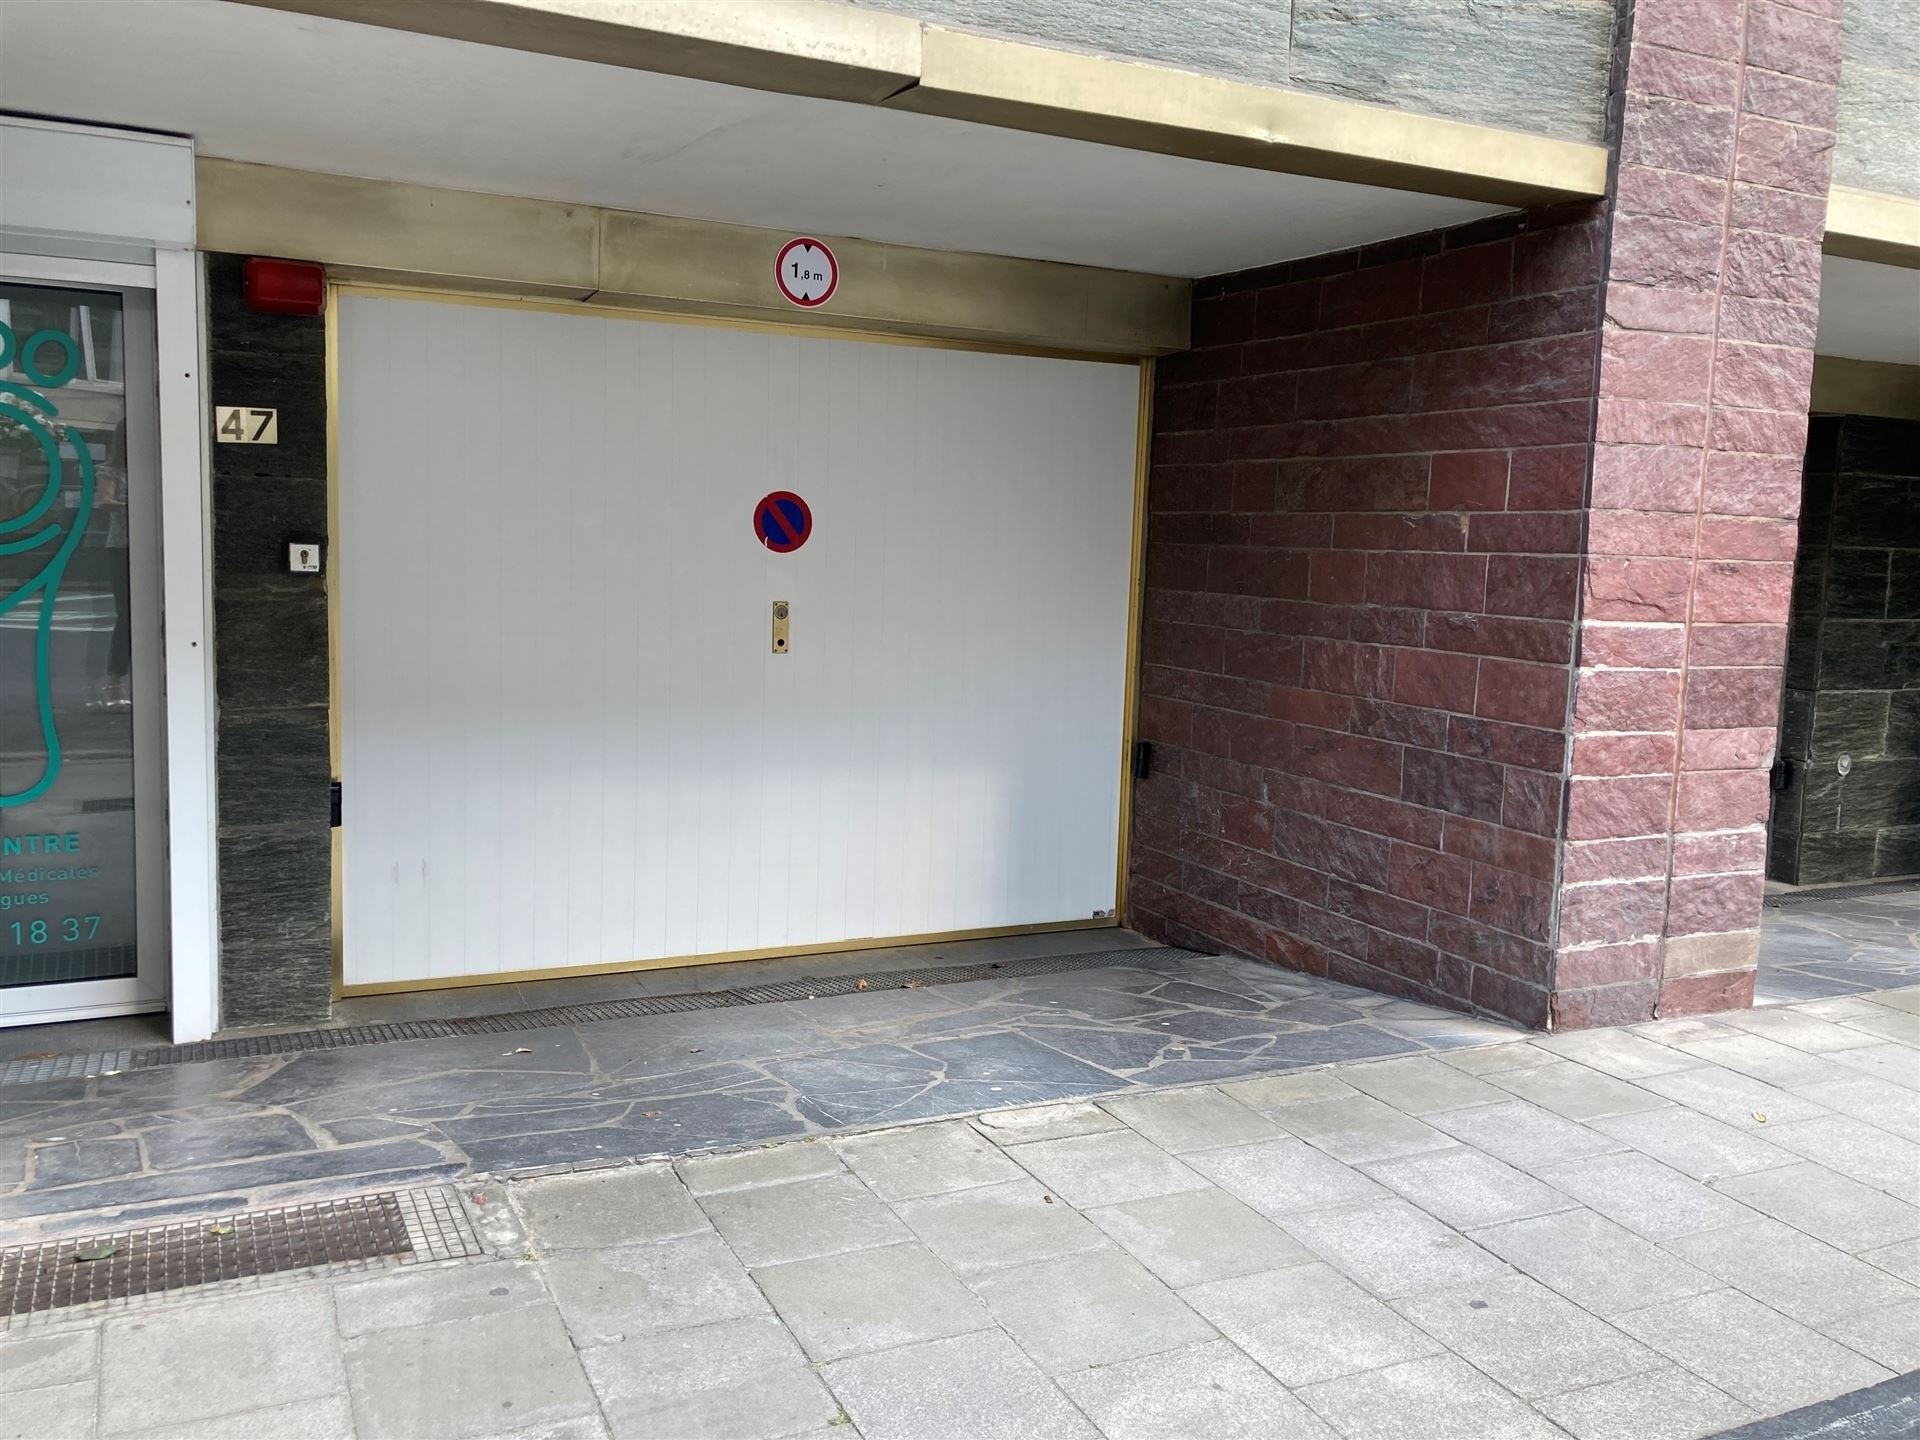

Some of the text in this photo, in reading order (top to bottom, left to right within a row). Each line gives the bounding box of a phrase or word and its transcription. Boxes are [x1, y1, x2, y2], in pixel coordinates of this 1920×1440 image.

[813, 273, 823, 281] m
[221, 409, 273, 441] 47
[2, 832, 80, 855] NTRE
[11, 916, 100, 945] 18 37
